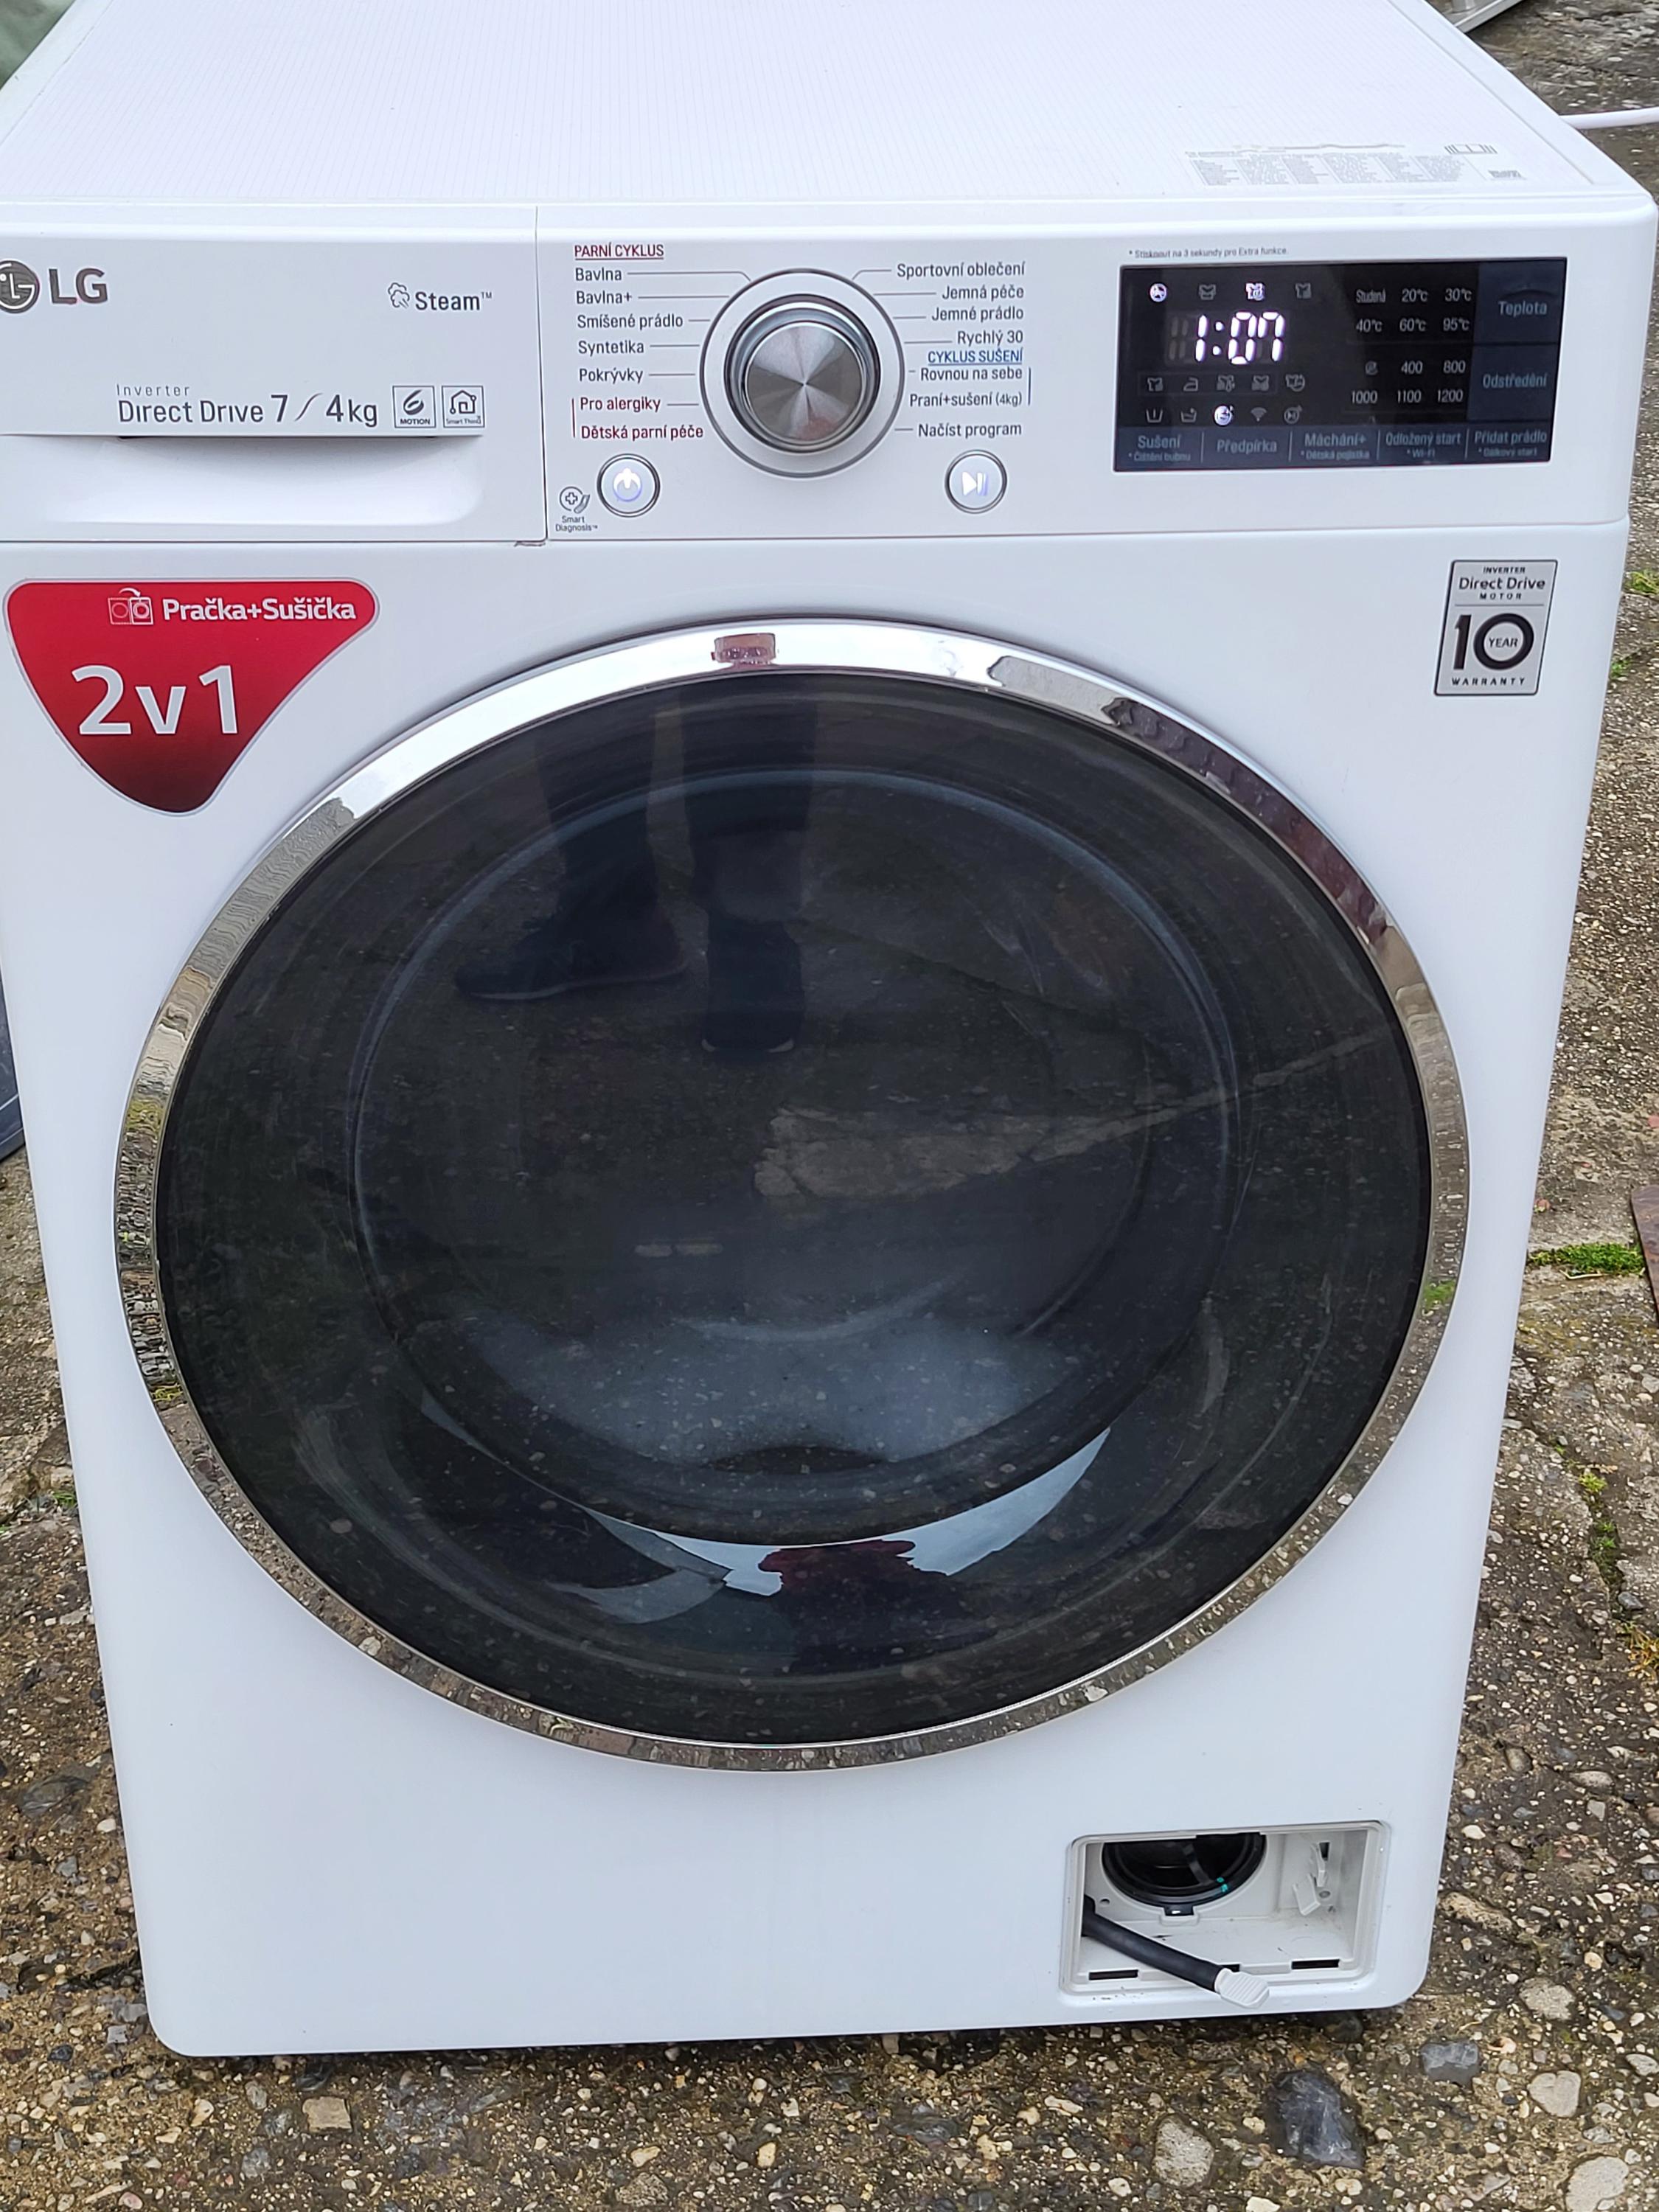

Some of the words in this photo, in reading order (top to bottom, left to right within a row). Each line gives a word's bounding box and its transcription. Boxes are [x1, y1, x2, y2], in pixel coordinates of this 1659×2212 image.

[574, 243, 612, 258] PARNÍ
[615, 243, 664, 257] CYKLUS
[1191, 248, 1222, 257] sekundy
[575, 267, 622, 282] Bavlna
[897, 262, 964, 279] Sportovní
[967, 261, 1025, 277] oblečení
[49, 268, 108, 305] LG
[942, 286, 988, 299] Jemná
[992, 285, 1024, 302] péče
[576, 291, 632, 305] Bavlna+
[1356, 288, 1386, 303] Studená
[931, 307, 976, 321] Jemné
[980, 306, 1024, 323] prádlo
[1498, 300, 1548, 316] Teplota
[577, 313, 636, 329] Smíšené
[639, 313, 684, 330] prádlo
[957, 330, 1004, 347] Rychlý
[1006, 330, 1023, 344] 30
[1194, 311, 1286, 365] 1:07
[578, 339, 644, 355] Syntetika
[928, 349, 975, 364] CYKLUS
[978, 346, 1023, 363] SUŠENÍ
[579, 367, 644, 384] Pokrývky
[920, 367, 970, 381] Rovnou
[973, 370, 987, 380] na
[991, 366, 1023, 380] sebe
[1401, 361, 1423, 375] 400
[1443, 361, 1466, 374] 800
[1483, 373, 1548, 389] Odstředění
[116, 383, 189, 397] Inverter
[1351, 390, 1378, 404] 1000
[1397, 389, 1422, 403] 1100
[1438, 389, 1463, 403] 1200
[580, 396, 602, 411] Pro
[605, 395, 661, 414] alergiky
[910, 392, 993, 408] Praní+sušení
[995, 392, 1023, 406] (4kg)
[119, 400, 192, 423] Direct
[201, 400, 264, 423] Drive
[581, 425, 627, 439] Dětská
[631, 425, 666, 442] parní
[669, 425, 703, 442] péče
[918, 422, 962, 437] Načíst
[964, 424, 1022, 439] program
[1475, 430, 1509, 442] Přidat
[1512, 431, 1547, 443] prádlo
[1137, 434, 1180, 448] Sušení
[1217, 439, 1277, 454] Předpírka
[1304, 431, 1366, 447] Máchání+
[1386, 431, 1433, 448] Odložený
[1437, 431, 1461, 444] start
[562, 515, 584, 524] Smart
[1459, 577, 1503, 590] Direct
[1507, 577, 1545, 589] Drive
[162, 597, 356, 621] Pračka+Sušička
[1453, 613, 1534, 670] 10
[1489, 638, 1518, 647] YEAR
[1452, 678, 1526, 686] WARRANTY
[72, 665, 131, 734] 2
[136, 686, 187, 734] v
[199, 665, 237, 734] 1
